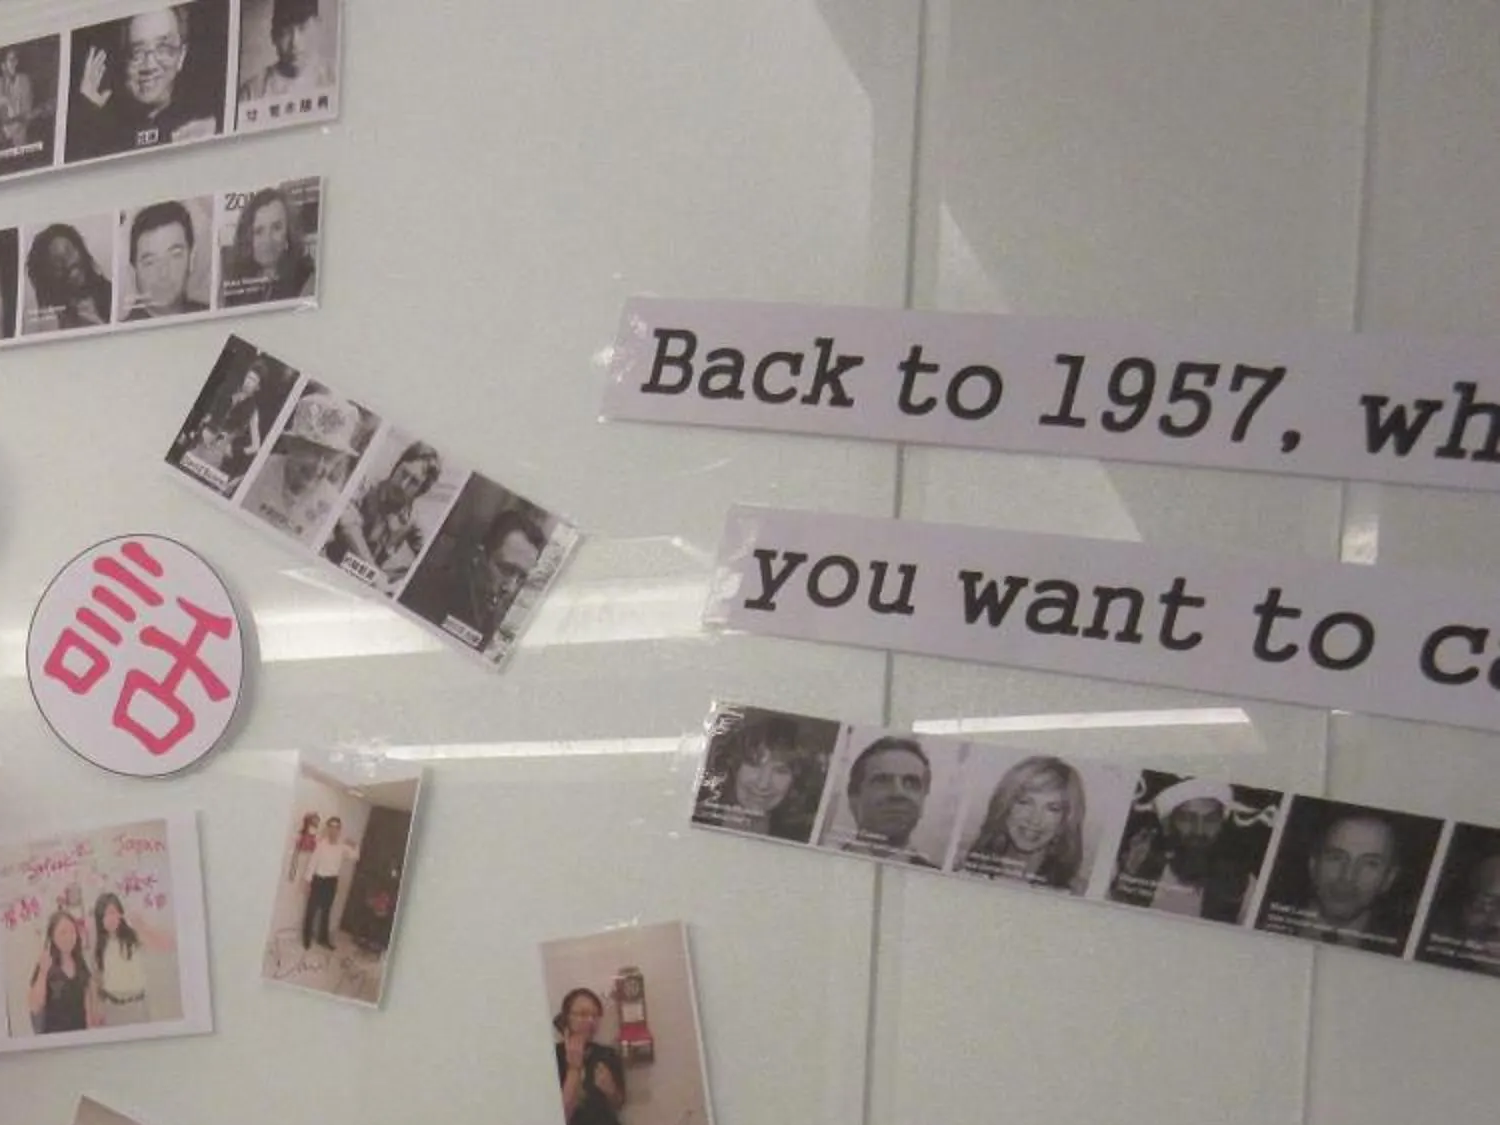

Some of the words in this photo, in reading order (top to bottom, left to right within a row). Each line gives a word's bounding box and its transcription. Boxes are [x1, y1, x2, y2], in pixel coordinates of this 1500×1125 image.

[641, 329, 863, 407] Back
[899, 346, 1002, 419] to
[1040, 354, 1300, 453] 1957,
[1360, 381, 1500, 463] wh
[44, 543, 233, 755] 話
[745, 550, 916, 614] you
[959, 571, 1204, 650] want
[1254, 588, 1374, 670] to
[1420, 625, 1500, 690] c
